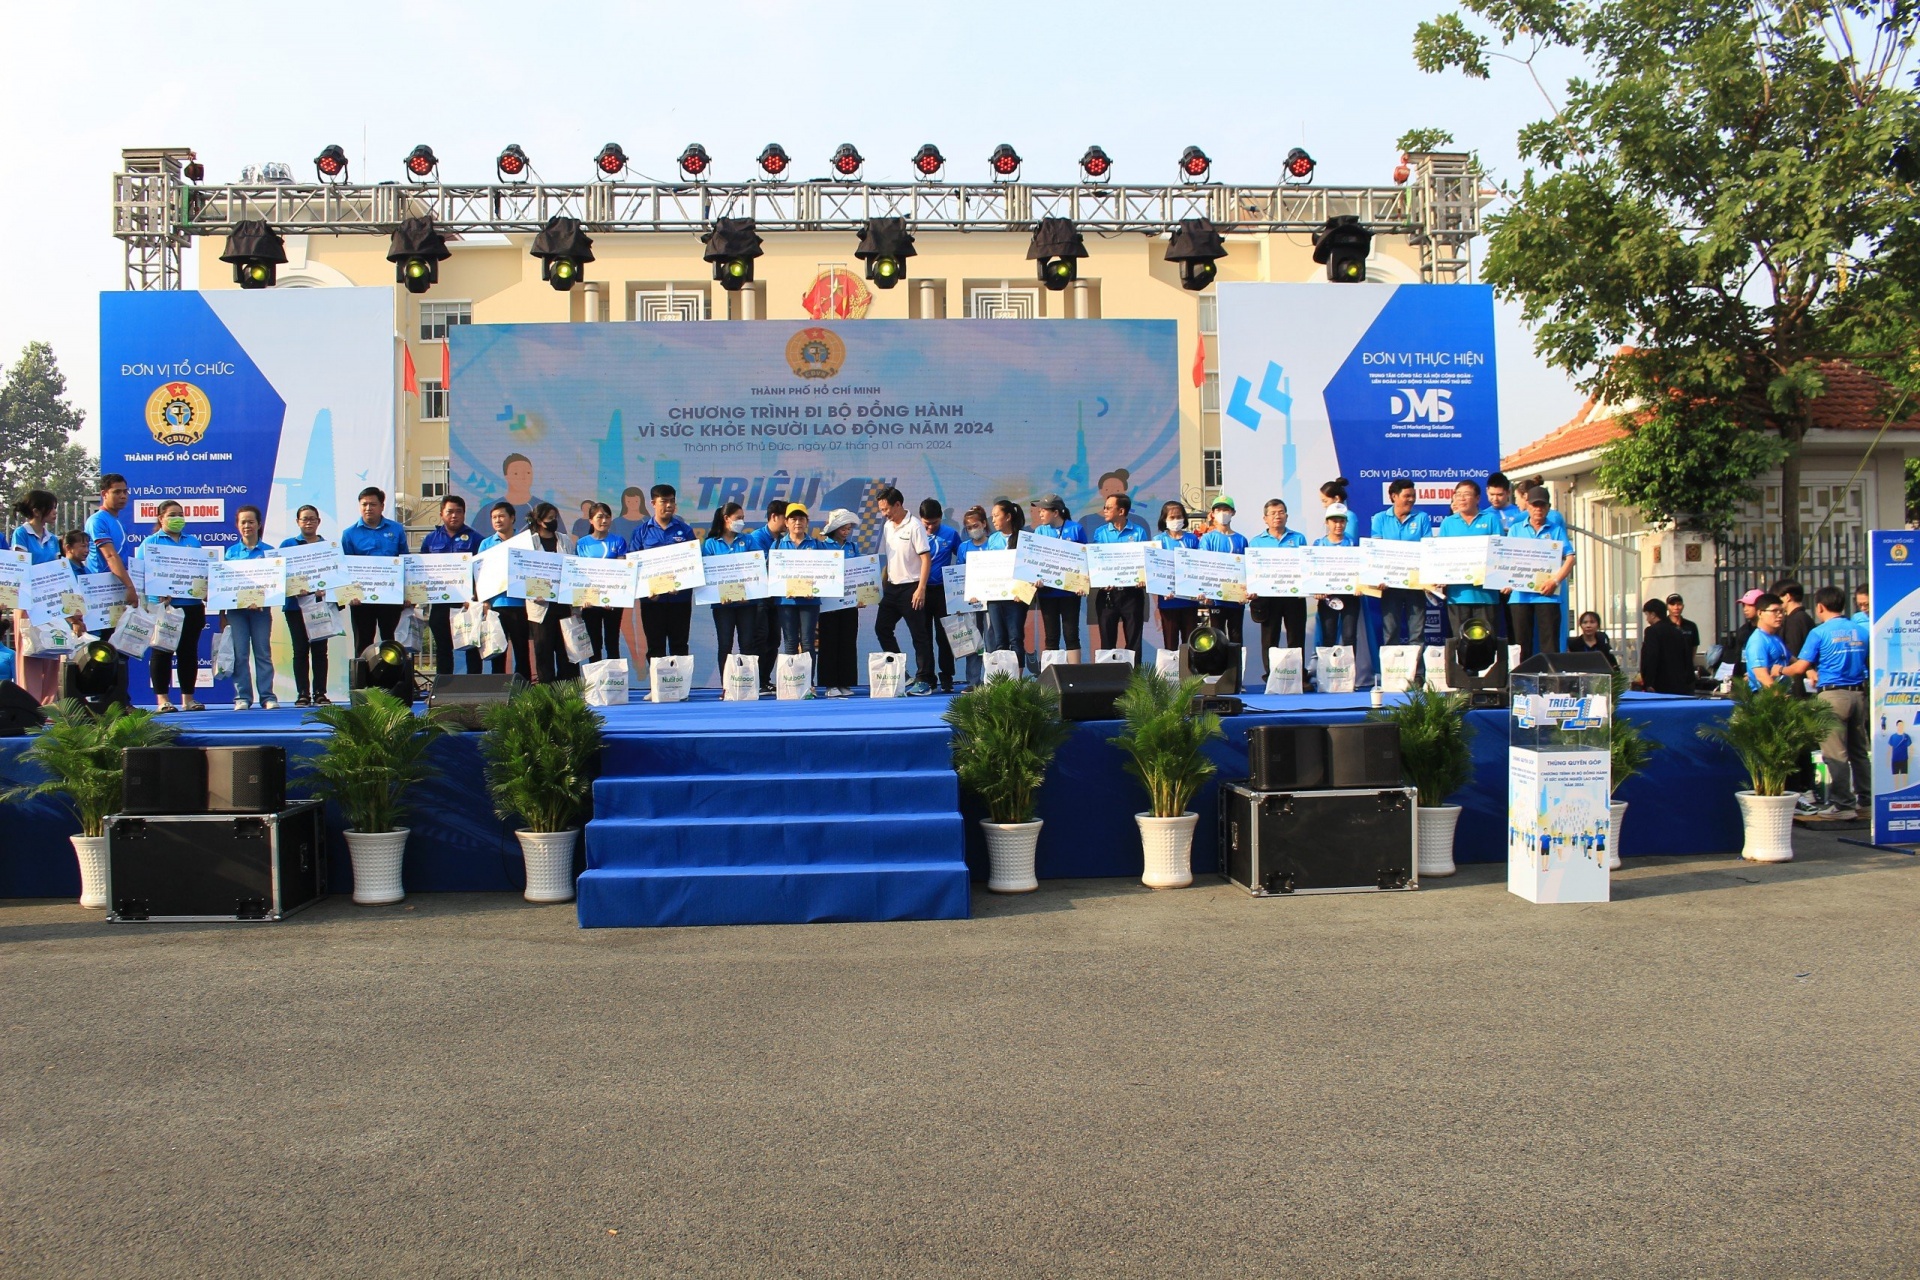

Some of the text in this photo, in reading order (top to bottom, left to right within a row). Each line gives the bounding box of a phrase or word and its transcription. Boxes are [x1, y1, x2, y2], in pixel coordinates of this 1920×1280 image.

[1362, 350, 1484, 367] ĐƠN VỊ THỰC HIỆN
[121, 358, 235, 377] ĐƠN VỊ TỔ CHỨC
[751, 386, 786, 396] THÀNH
[788, 384, 810, 395] PHỐ
[832, 384, 851, 395] CHÍ
[854, 386, 881, 395] MINH
[668, 400, 964, 420] CHƯƠNG TRÌNH ĐI BỘ ĐỒNG HÀNH
[1390, 388, 1454, 422] DMS
[638, 420, 994, 438] VÌ SỨC KHỎE NGƯỜI LAO ĐỘNG NĂM 2024
[684, 440, 952, 452] Thành phố Thủ Đức, ngày 07 tháng 01 năm 2024
[124, 452, 154, 462] THÀNH
[156, 451, 174, 461] PHỐ
[192, 452, 208, 461] CHÍ
[210, 453, 233, 461] MINH
[1360, 468, 1489, 479] ĐƠN VỊ BẢO TRỢ TRUYỀN THÔNG
[132, 486, 142, 496] VỊ
[144, 484, 163, 495] BẢO
[165, 486, 182, 496] TRỢ
[184, 484, 214, 494] TRUYỀN
[216, 484, 247, 494] THÔNG
[1419, 489, 1436, 499] LAO
[193, 506, 219, 518] ĐỘNG
[127, 532, 142, 543] ƠN
[204, 532, 238, 542] CƯƠNG
[1549, 696, 1576, 709] TRIỆU
